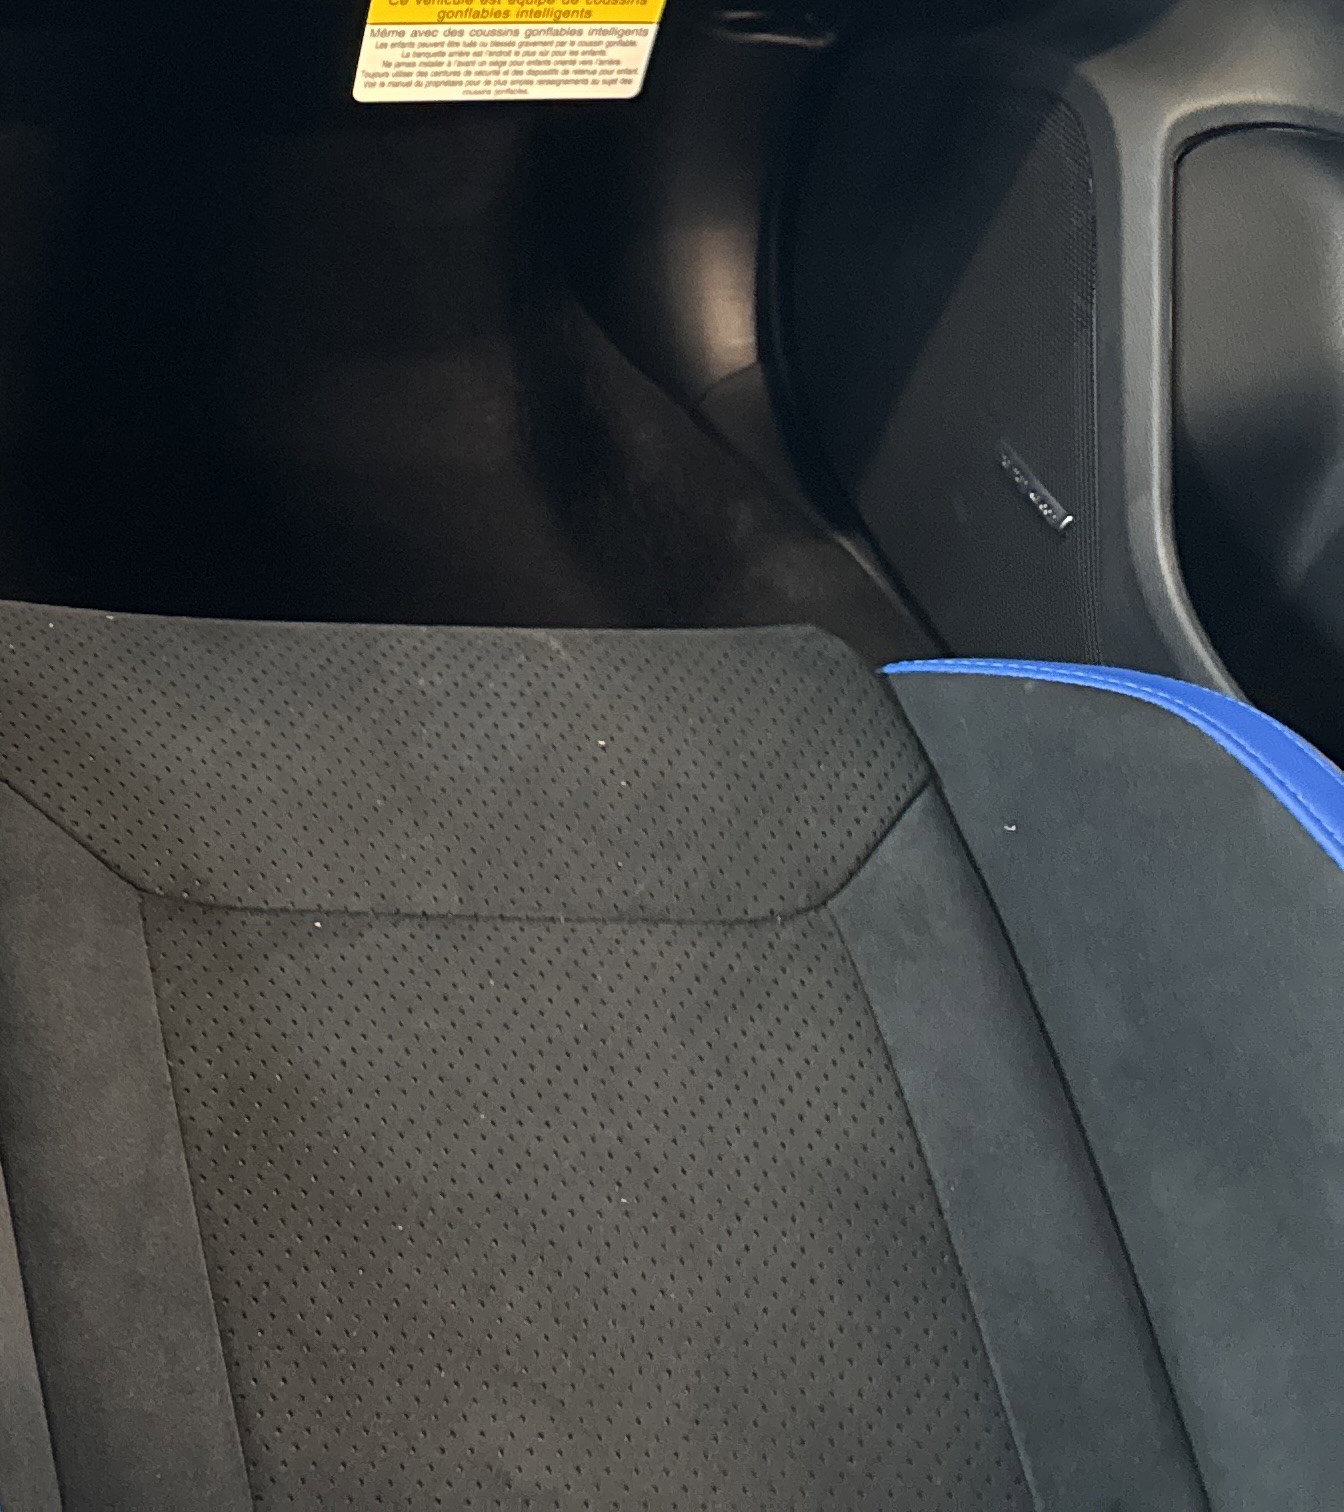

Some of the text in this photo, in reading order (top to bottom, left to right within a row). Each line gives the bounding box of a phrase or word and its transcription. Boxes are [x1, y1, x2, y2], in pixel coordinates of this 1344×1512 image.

[437, 8, 593, 23] gonflables intelligents
[410, 29, 439, 38] avec
[443, 28, 465, 37] des
[469, 28, 520, 37] coussins
[524, 27, 584, 39] gonflables
[588, 27, 649, 38] intelligents
